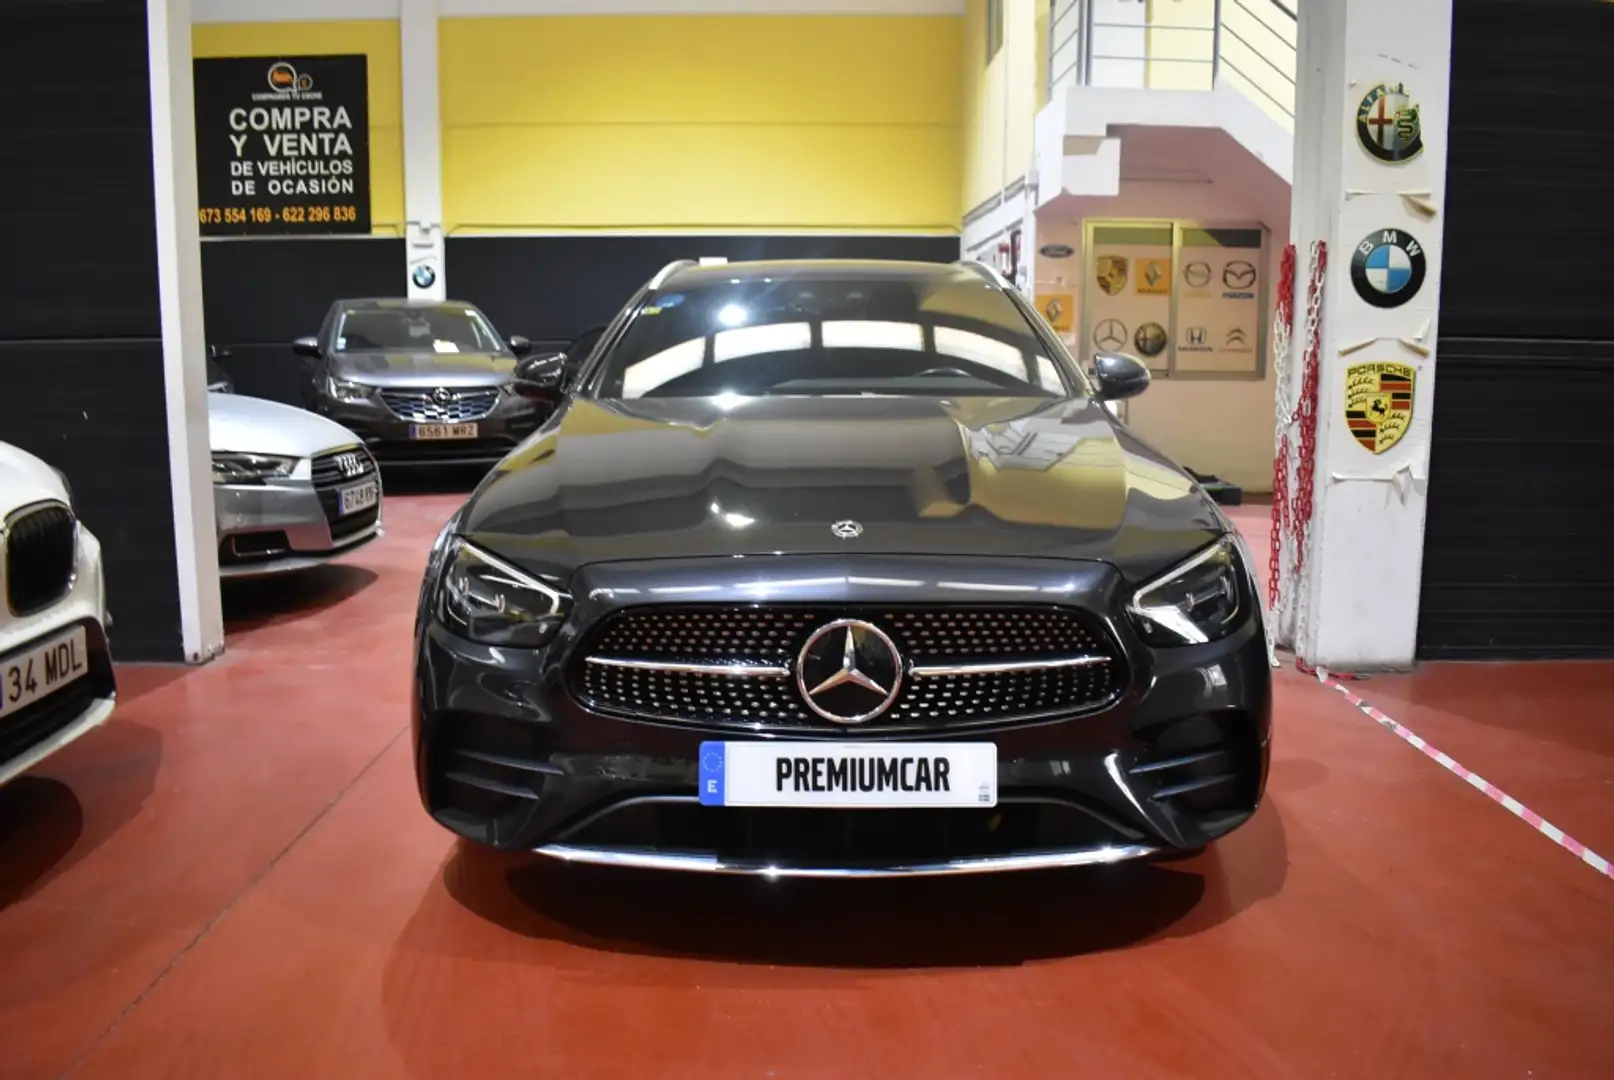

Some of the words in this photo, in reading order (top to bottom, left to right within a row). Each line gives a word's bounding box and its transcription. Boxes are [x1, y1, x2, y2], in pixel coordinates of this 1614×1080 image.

[229, 106, 352, 131] COMPRA
[229, 134, 247, 157] Y
[263, 133, 353, 156] VENTA
[230, 161, 253, 176] DE
[257, 157, 353, 176] VEHÍCULOS
[231, 180, 256, 195] DE
[268, 176, 354, 195] OCASIÓN
[199, 208, 221, 224] 673
[224, 208, 247, 223] 554
[251, 207, 271, 223] 169
[282, 206, 305, 222] 622
[308, 206, 330, 222] 296
[333, 206, 356, 221] 836
[1359, 230, 1421, 257] BMW
[1347, 363, 1411, 378] PORSCHE
[44, 638, 82, 686] MDL
[775, 757, 951, 792] PREMIUMCAR
[707, 780, 718, 793] E
